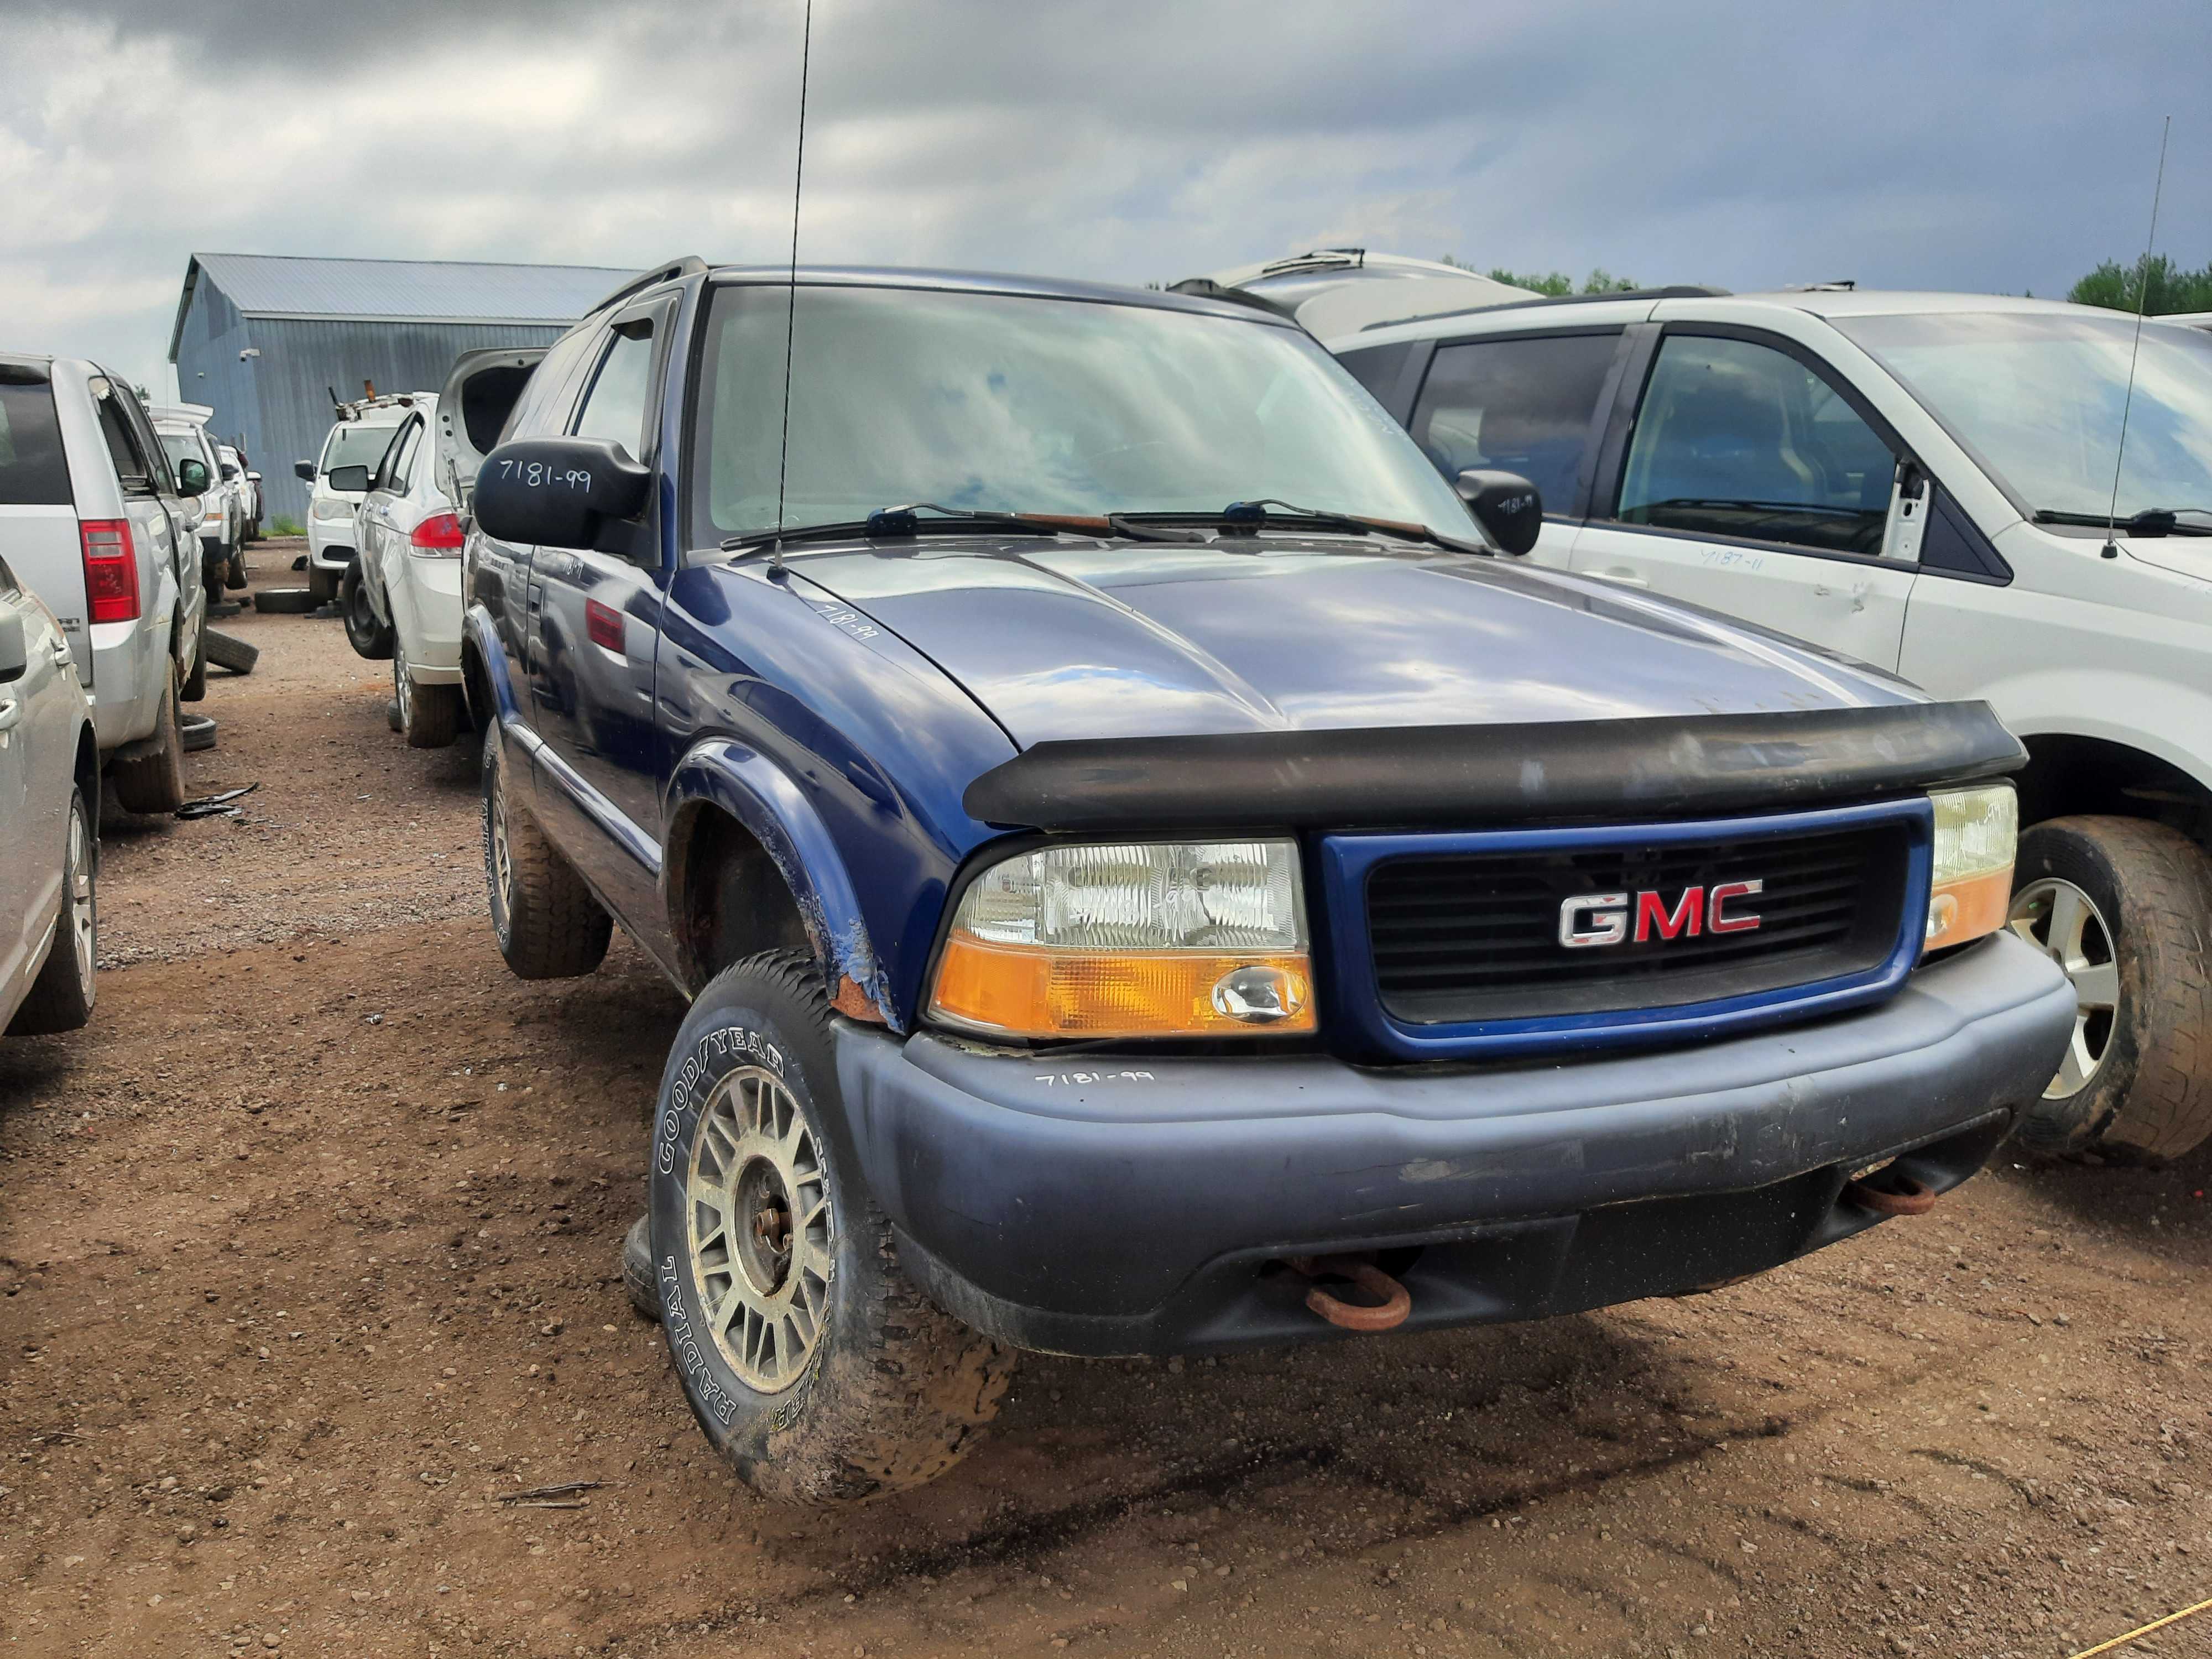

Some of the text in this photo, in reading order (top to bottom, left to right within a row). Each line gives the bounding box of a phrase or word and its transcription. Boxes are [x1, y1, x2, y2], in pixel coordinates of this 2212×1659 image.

[500, 460, 591, 493] 7181-99
[1559, 879, 1763, 948] GMC
[659, 1027, 784, 1175] GOODYEAR
[1035, 1071, 1155, 1087] 7181-99
[661, 1256, 738, 1426] RADIAL
